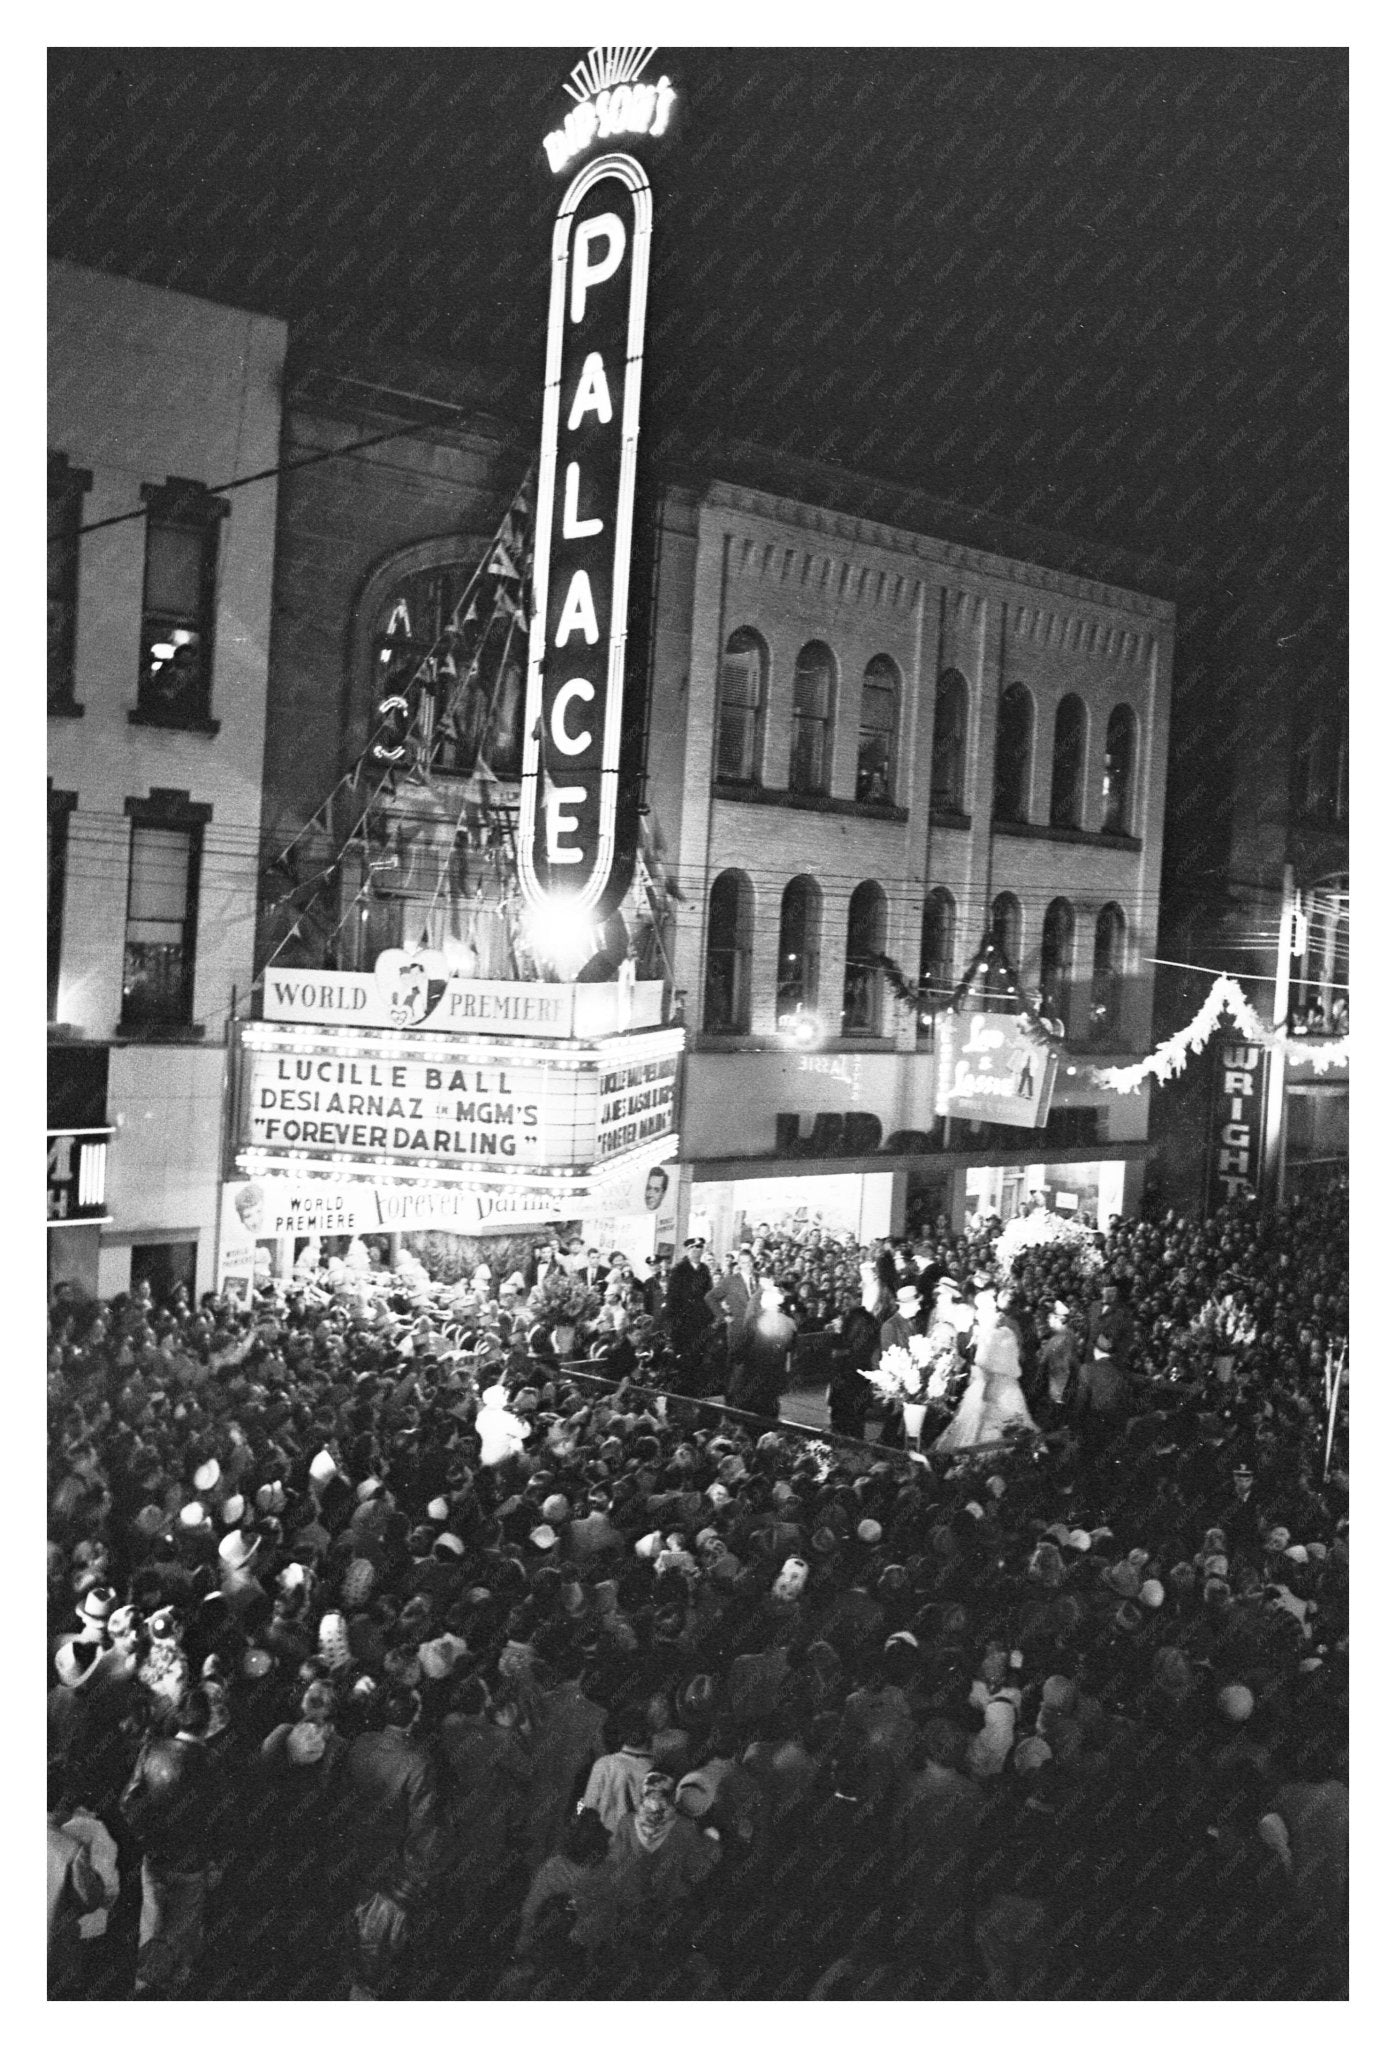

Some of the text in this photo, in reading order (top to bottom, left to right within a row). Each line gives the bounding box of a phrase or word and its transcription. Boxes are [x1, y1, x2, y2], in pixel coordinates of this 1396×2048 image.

[545, 211, 627, 867] PALACE
[273, 982, 564, 1024] WORLD PREMIERE
[278, 1058, 513, 1096] LUCILLE BALL
[260, 1088, 320, 1111] DESI
[326, 1093, 424, 1120] ARNAZ
[456, 1100, 539, 1127] MGM'S
[1218, 1046, 1259, 1202] WRIGHT
[276, 1212, 357, 1232] PREMIERE
[289, 1196, 346, 1213] WORLD
